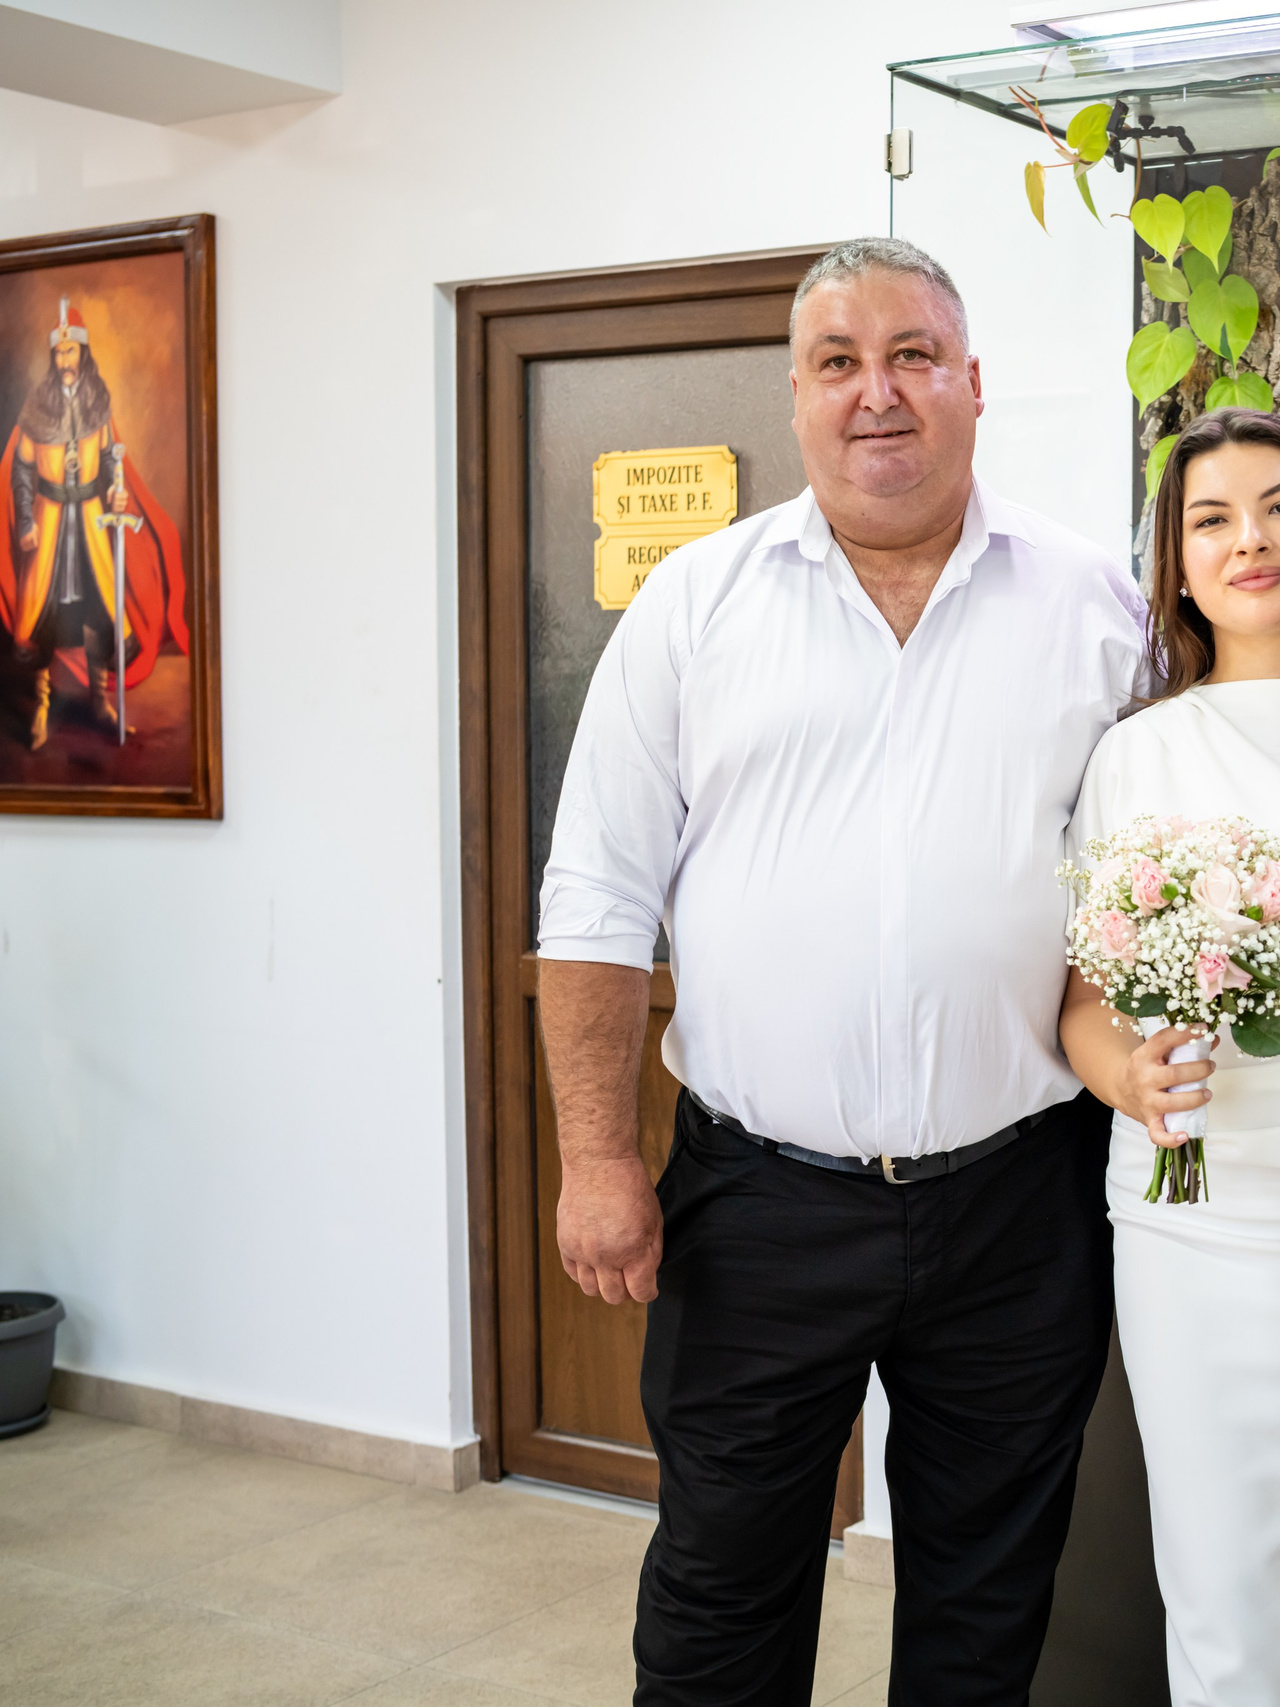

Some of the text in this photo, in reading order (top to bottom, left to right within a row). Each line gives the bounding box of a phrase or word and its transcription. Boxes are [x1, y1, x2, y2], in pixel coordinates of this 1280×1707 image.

[626, 464, 703, 486] IMPOZITE
[639, 493, 678, 513] TAXE
[627, 545, 681, 565] REGIS
